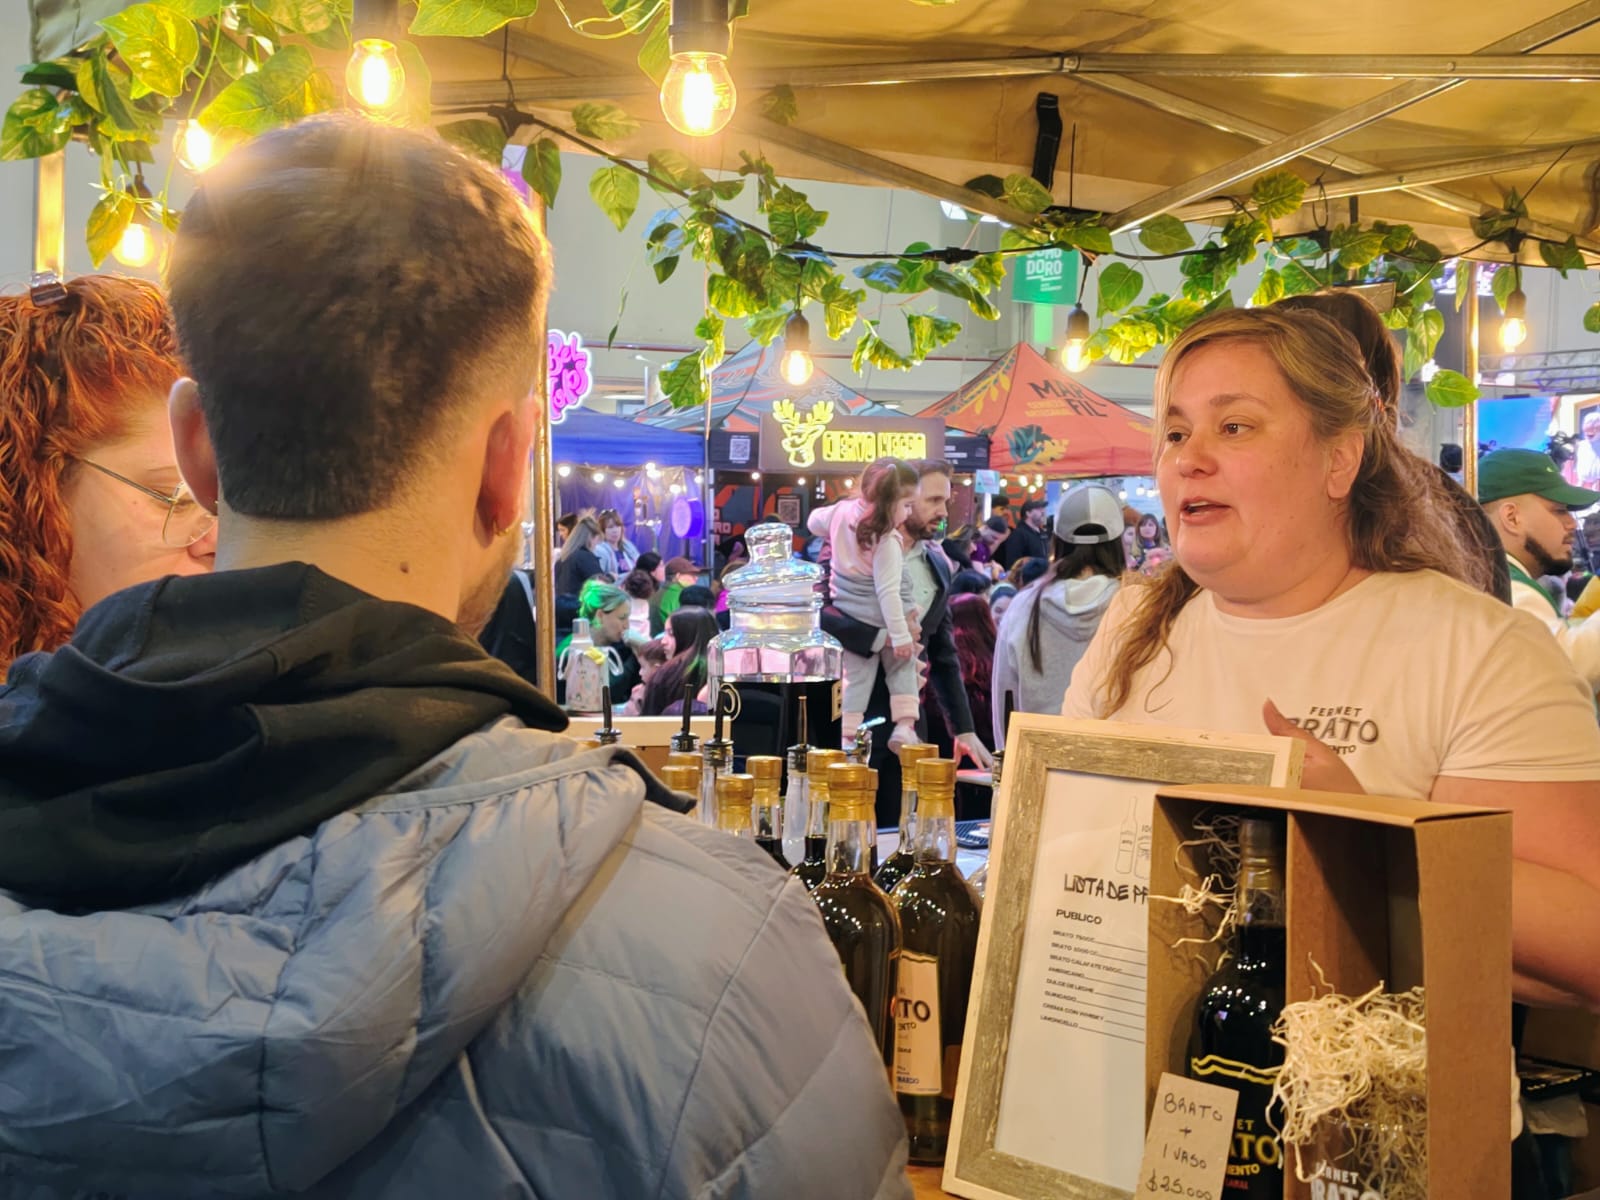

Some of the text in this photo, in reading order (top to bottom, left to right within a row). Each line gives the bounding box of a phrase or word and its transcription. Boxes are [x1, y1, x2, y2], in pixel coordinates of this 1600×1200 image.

[1026, 259, 1062, 276] DORO
[1063, 398, 1108, 417] FIL
[1309, 706, 1362, 717] FERNET
[1063, 873, 1104, 898] LISTA
[1106, 880, 1129, 901] DE
[1055, 908, 1103, 925] PUBLICO
[1164, 1092, 1223, 1122] BRATO
[1174, 1147, 1207, 1170] VASO
